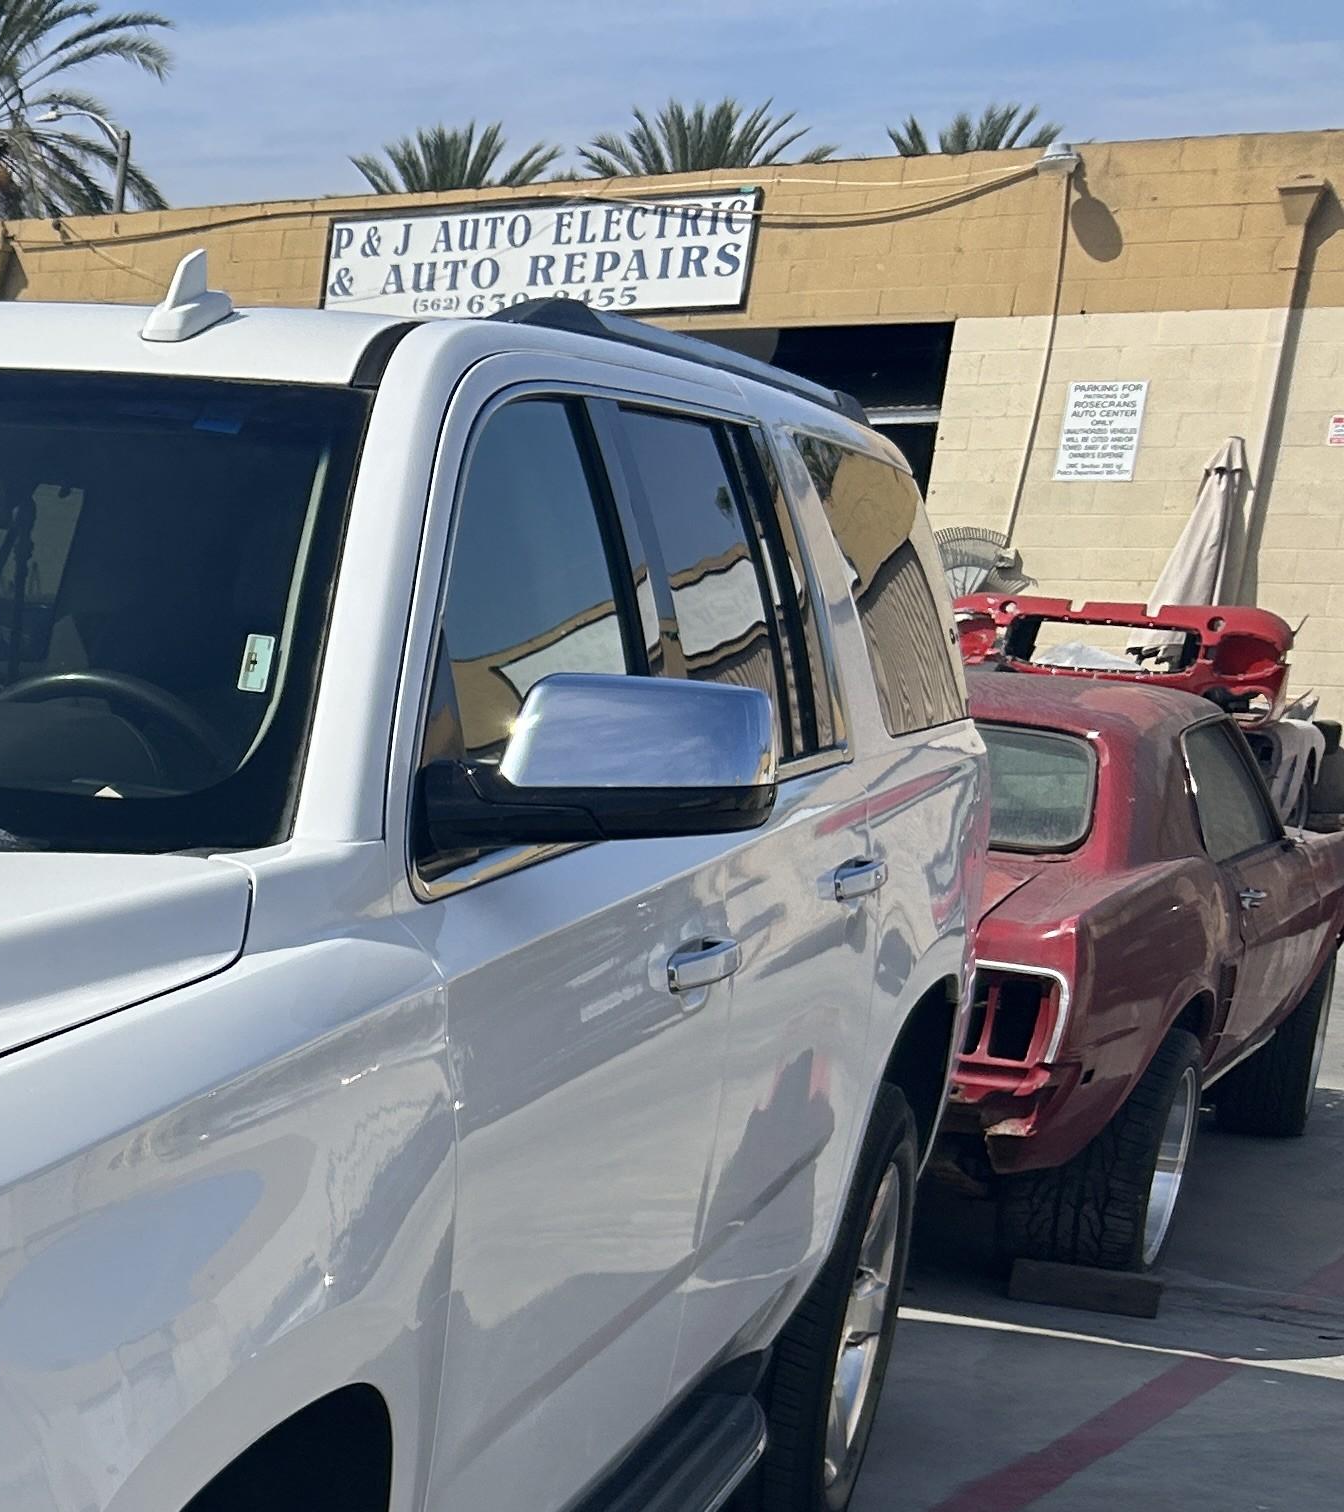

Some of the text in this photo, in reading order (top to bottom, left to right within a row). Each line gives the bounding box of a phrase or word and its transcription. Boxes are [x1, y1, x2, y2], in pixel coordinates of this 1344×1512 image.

[331, 199, 748, 259] P & J AUTO ELECTRIC
[328, 242, 743, 297] & AUTO REPAIRS
[412, 296, 460, 314] (562)
[1074, 384, 1143, 392] PARKING FOR
[1073, 400, 1137, 408] ROSECRANS
[1099, 409, 1137, 417] CENTER
